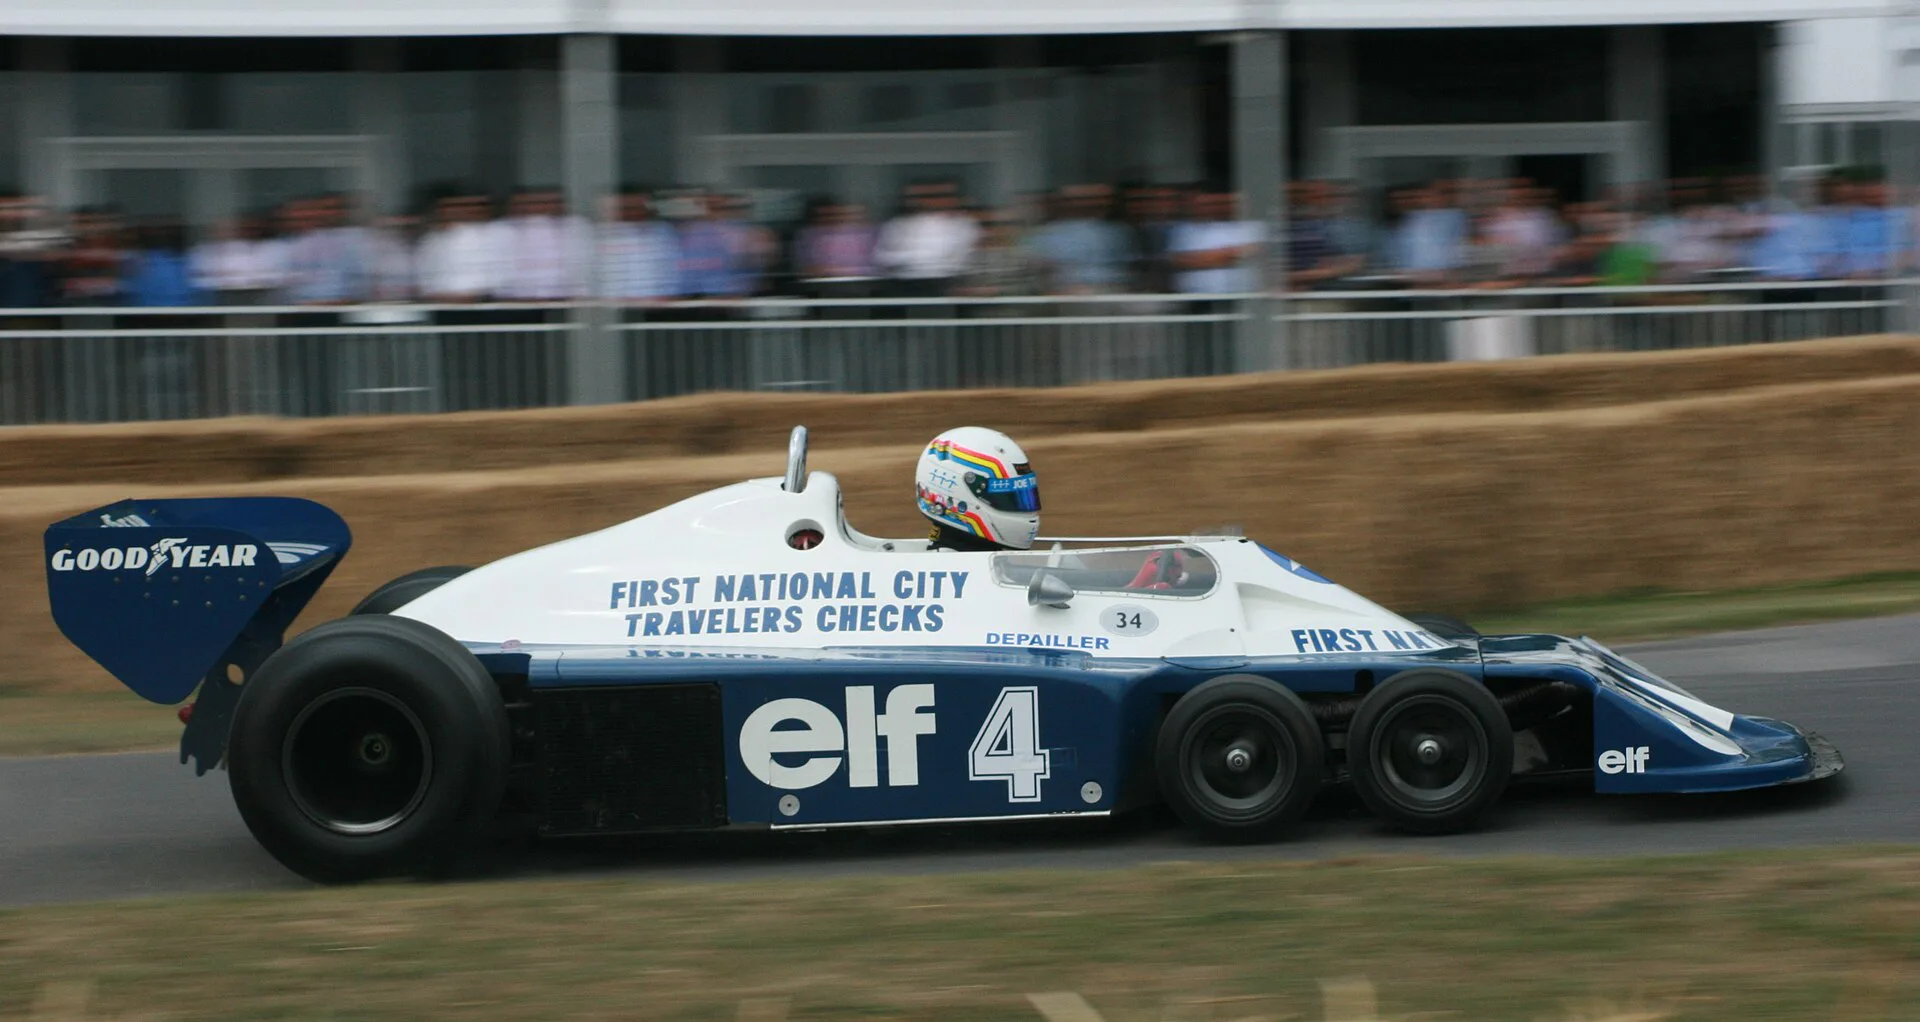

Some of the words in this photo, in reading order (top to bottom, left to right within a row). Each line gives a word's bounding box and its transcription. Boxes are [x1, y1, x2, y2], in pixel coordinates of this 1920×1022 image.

[1012, 479, 1027, 489] JOE
[610, 577, 700, 610] FIRST
[714, 573, 876, 602] NATIONAL
[893, 570, 969, 599] CITY
[624, 607, 803, 637] TRAVELERS
[817, 604, 945, 632] CHECKS
[1115, 612, 1142, 629] 34
[986, 632, 1109, 650] DEPAILLER
[1290, 628, 1379, 653] FIRST
[739, 683, 936, 789] elf
[968, 685, 1050, 803] 4
[1598, 746, 1649, 774] elf
